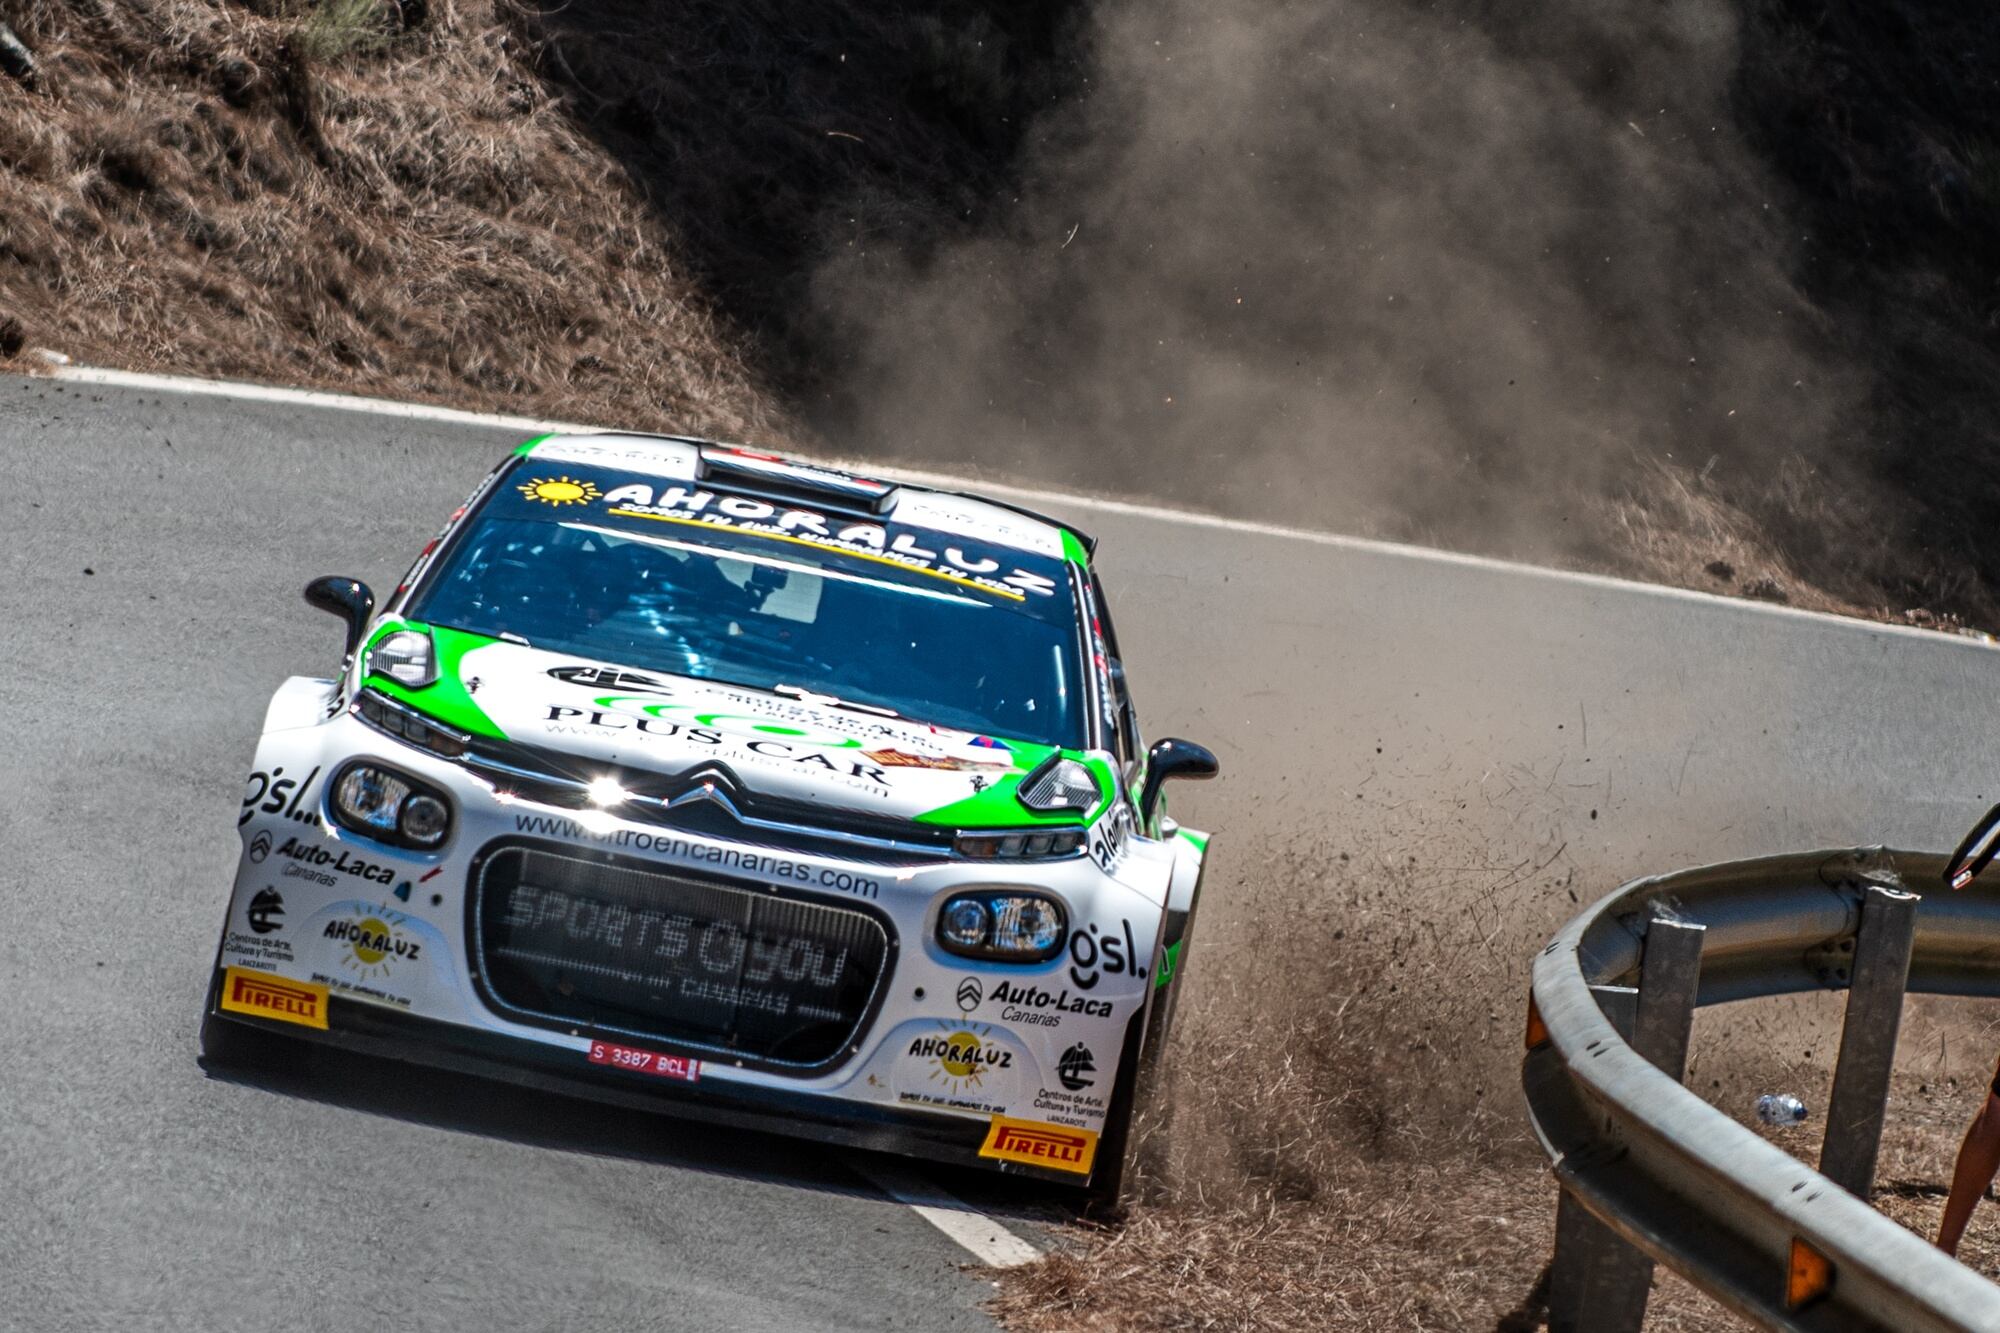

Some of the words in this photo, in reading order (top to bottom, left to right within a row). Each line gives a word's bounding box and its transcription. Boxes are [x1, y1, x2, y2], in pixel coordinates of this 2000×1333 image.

[602, 484, 1056, 597] AHORALUZ
[541, 703, 722, 745] PLUS
[746, 740, 893, 787] CAR
[276, 837, 395, 886] Auto-Laca
[283, 862, 338, 888] Canarias
[324, 920, 421, 961] AHORALUZ
[232, 976, 318, 1018] PIRELLI
[989, 980, 1114, 1019] Auto-Laca
[1001, 1005, 1061, 1028] Canarias
[593, 1045, 605, 1059] S
[612, 1048, 652, 1068] 3387
[656, 1056, 686, 1075] BCL
[909, 1038, 1012, 1069] AHORALUZ
[1033, 1098, 1065, 1112] Cultura
[1073, 1104, 1106, 1119] Turismo
[1038, 1087, 1072, 1102] Centros
[1073, 1094, 1085, 1105] de
[993, 1125, 1088, 1163] PIRELLI
